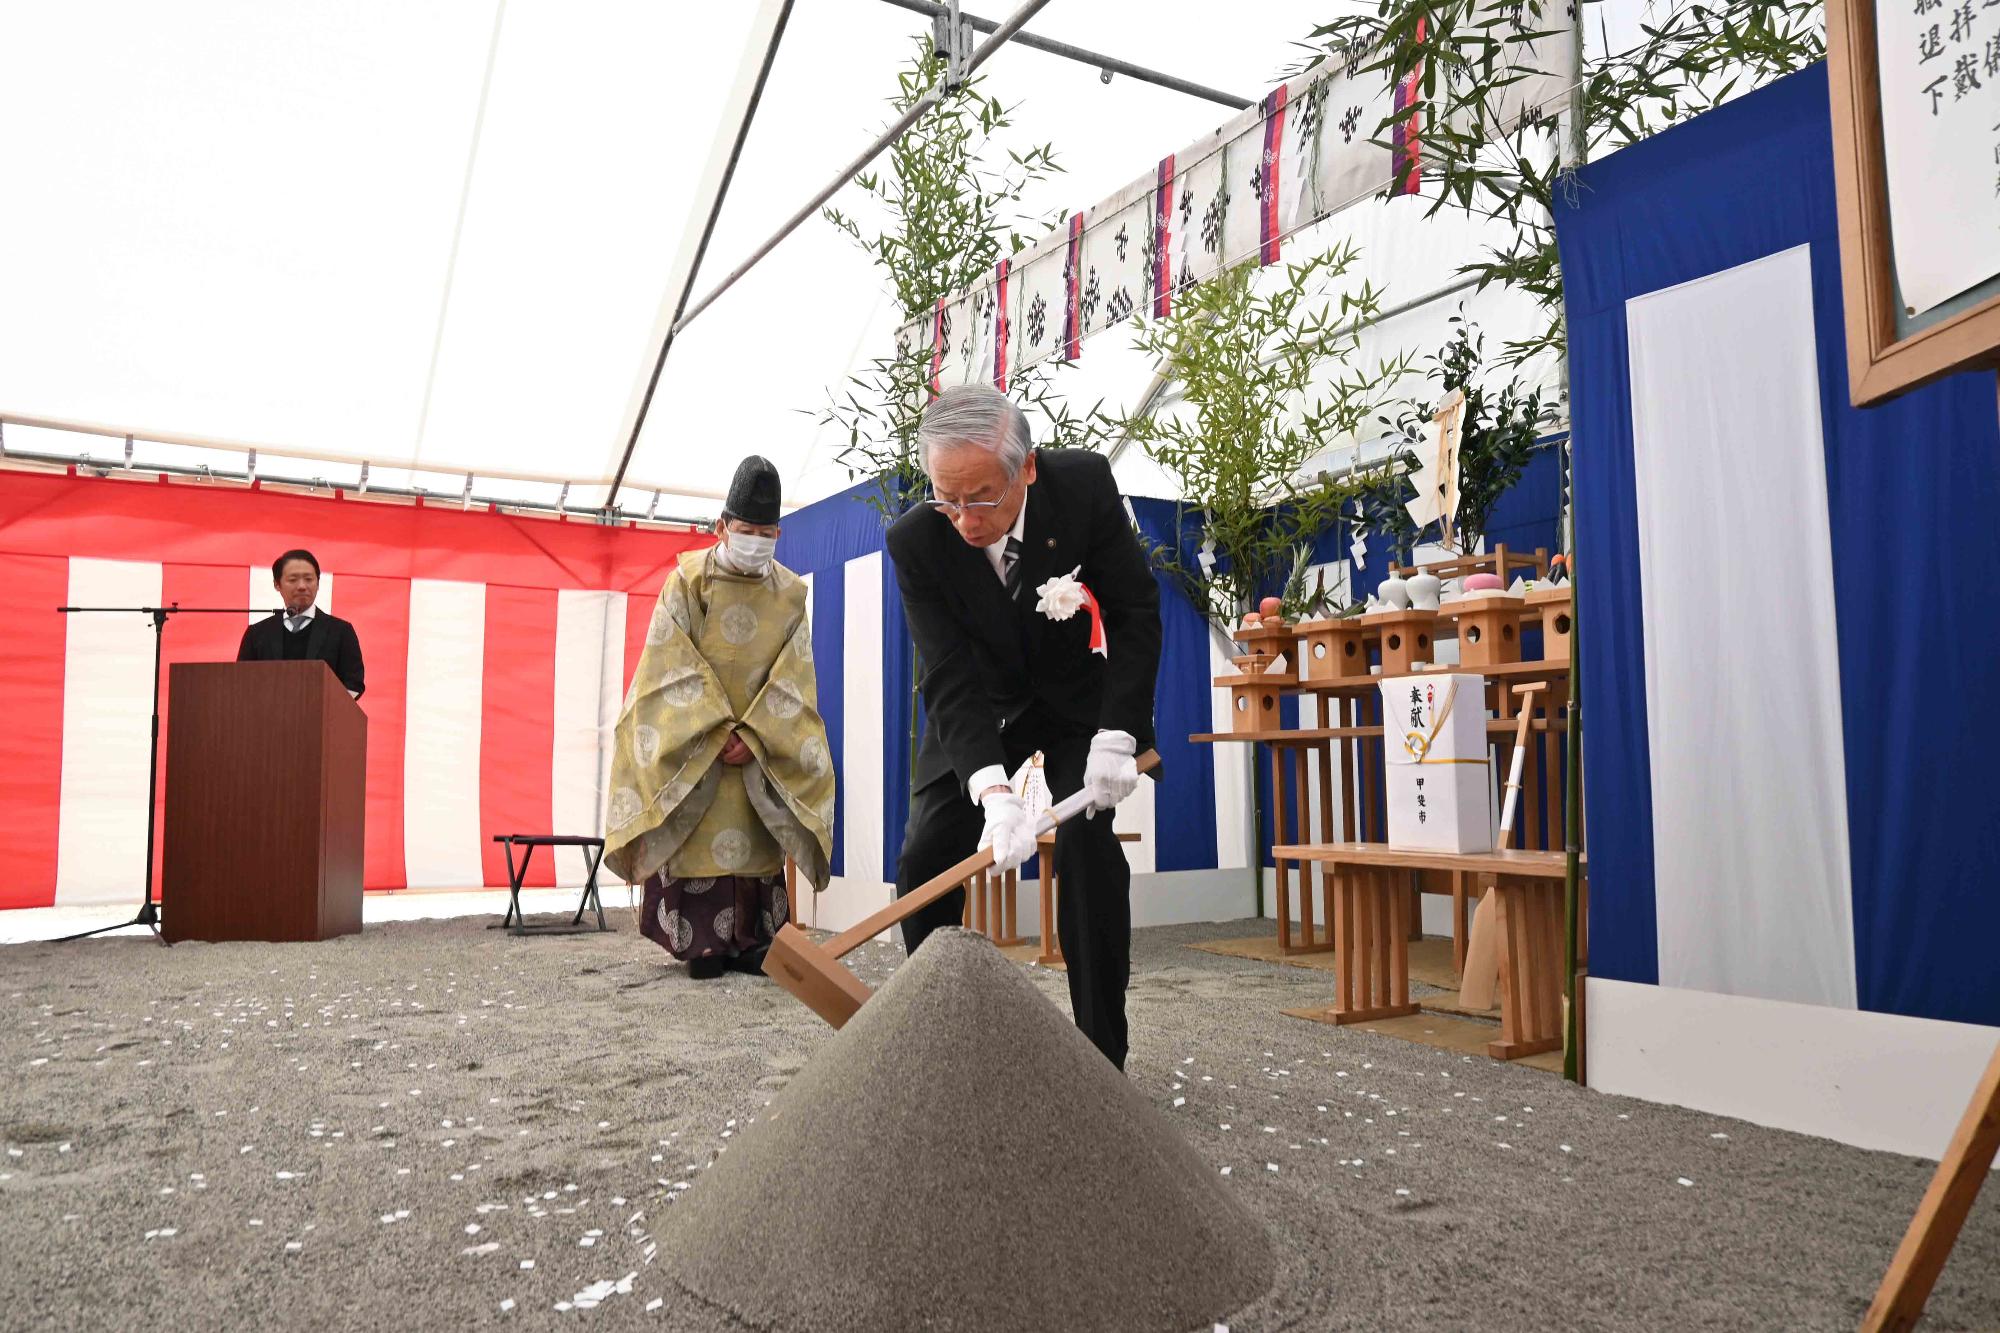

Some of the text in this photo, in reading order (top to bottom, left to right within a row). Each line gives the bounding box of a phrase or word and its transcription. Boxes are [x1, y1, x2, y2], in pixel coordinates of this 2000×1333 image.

[1410, 686, 1425, 728] 奉献
[1416, 777, 1427, 824] 甲斐市
